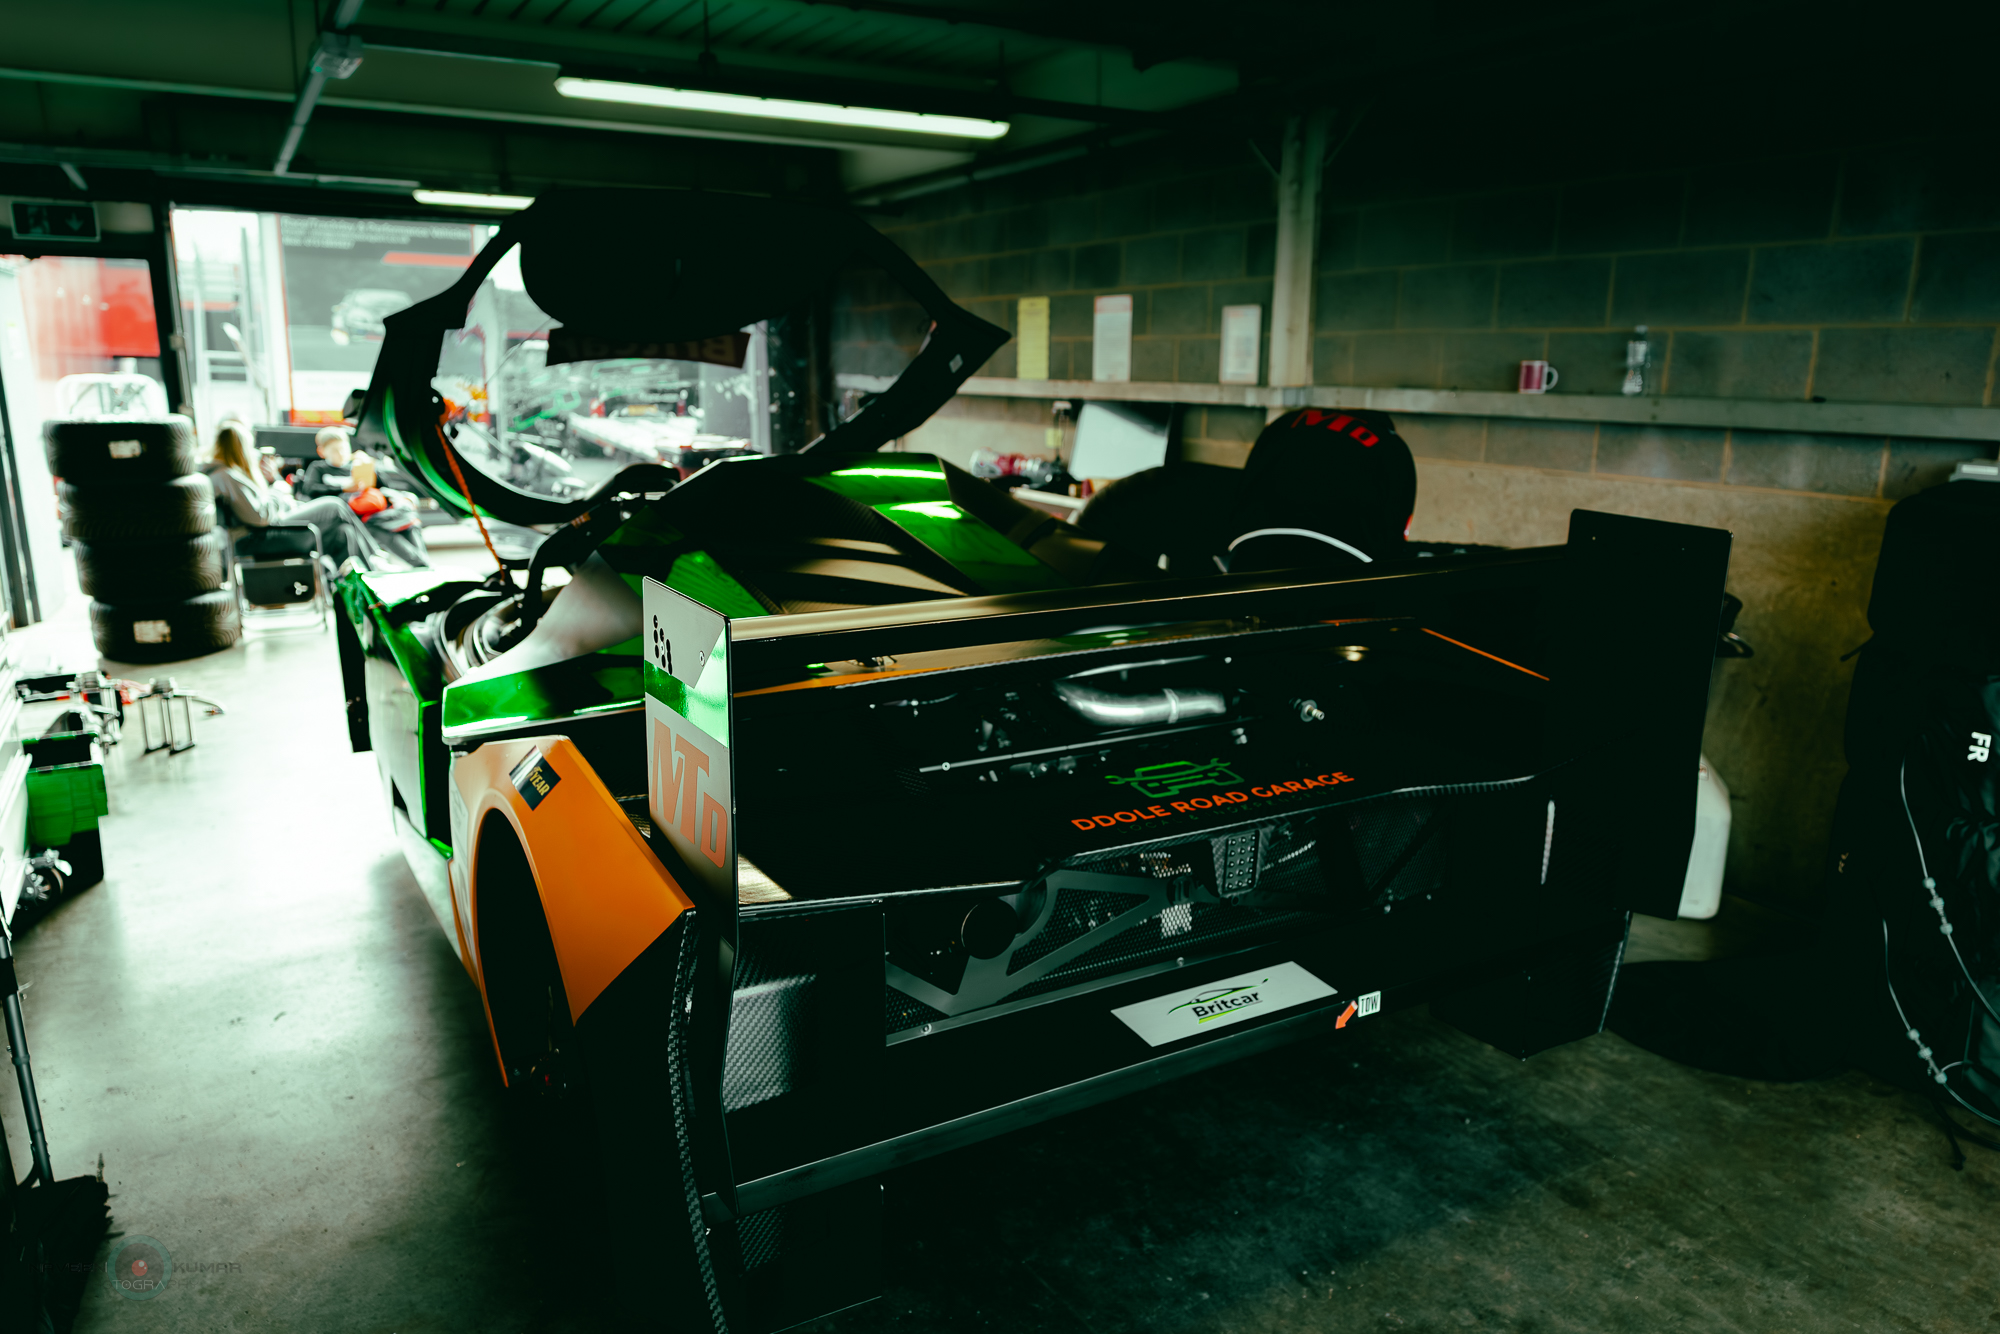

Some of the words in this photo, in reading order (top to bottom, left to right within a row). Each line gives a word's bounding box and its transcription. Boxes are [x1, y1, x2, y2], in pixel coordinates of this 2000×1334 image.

[1967, 731, 1992, 763] FR
[1071, 805, 1172, 831] DDOLE
[1170, 791, 1249, 814] ROAD
[1250, 771, 1356, 797] GARAGE
[1191, 990, 1260, 1019] Britcar
[1361, 995, 1379, 1014] TOW
